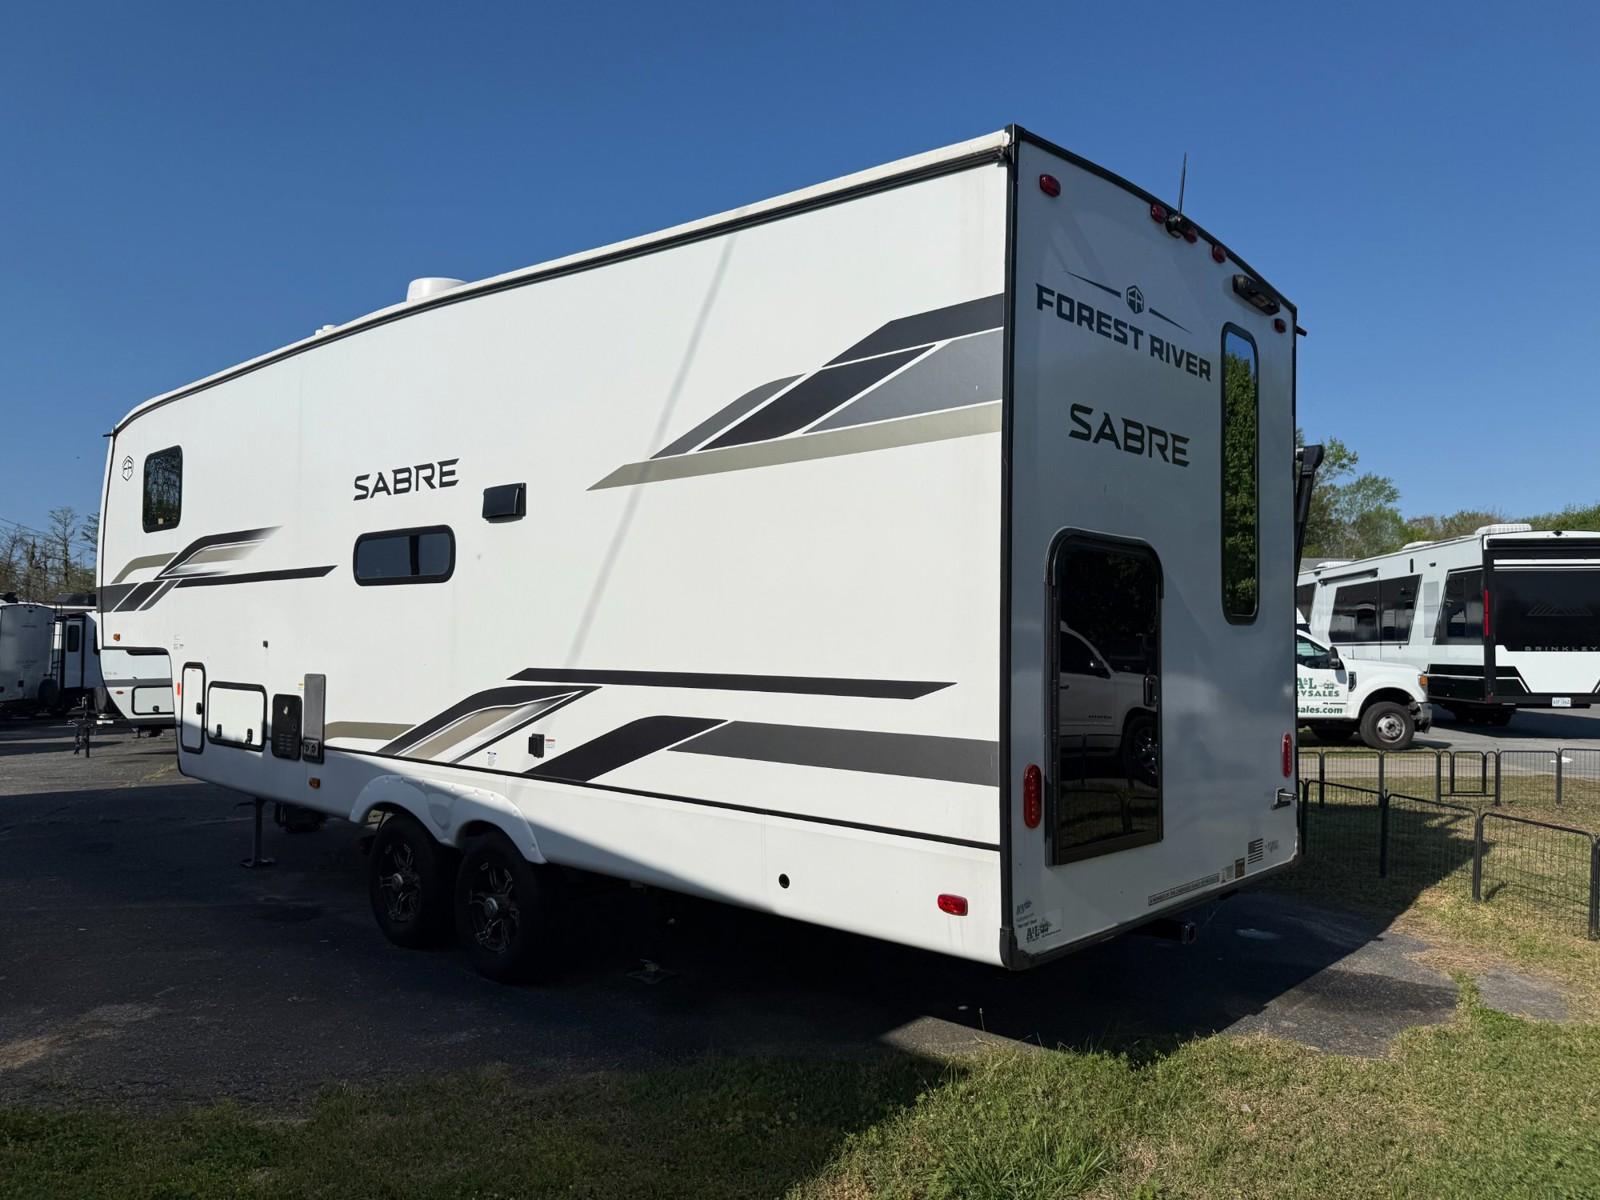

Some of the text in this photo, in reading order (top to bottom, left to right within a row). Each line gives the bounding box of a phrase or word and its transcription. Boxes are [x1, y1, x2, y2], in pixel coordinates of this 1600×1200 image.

[1036, 283, 1211, 382] FOREST RIVER
[1069, 403, 1190, 467] SABRE
[353, 458, 460, 501] SABRE
